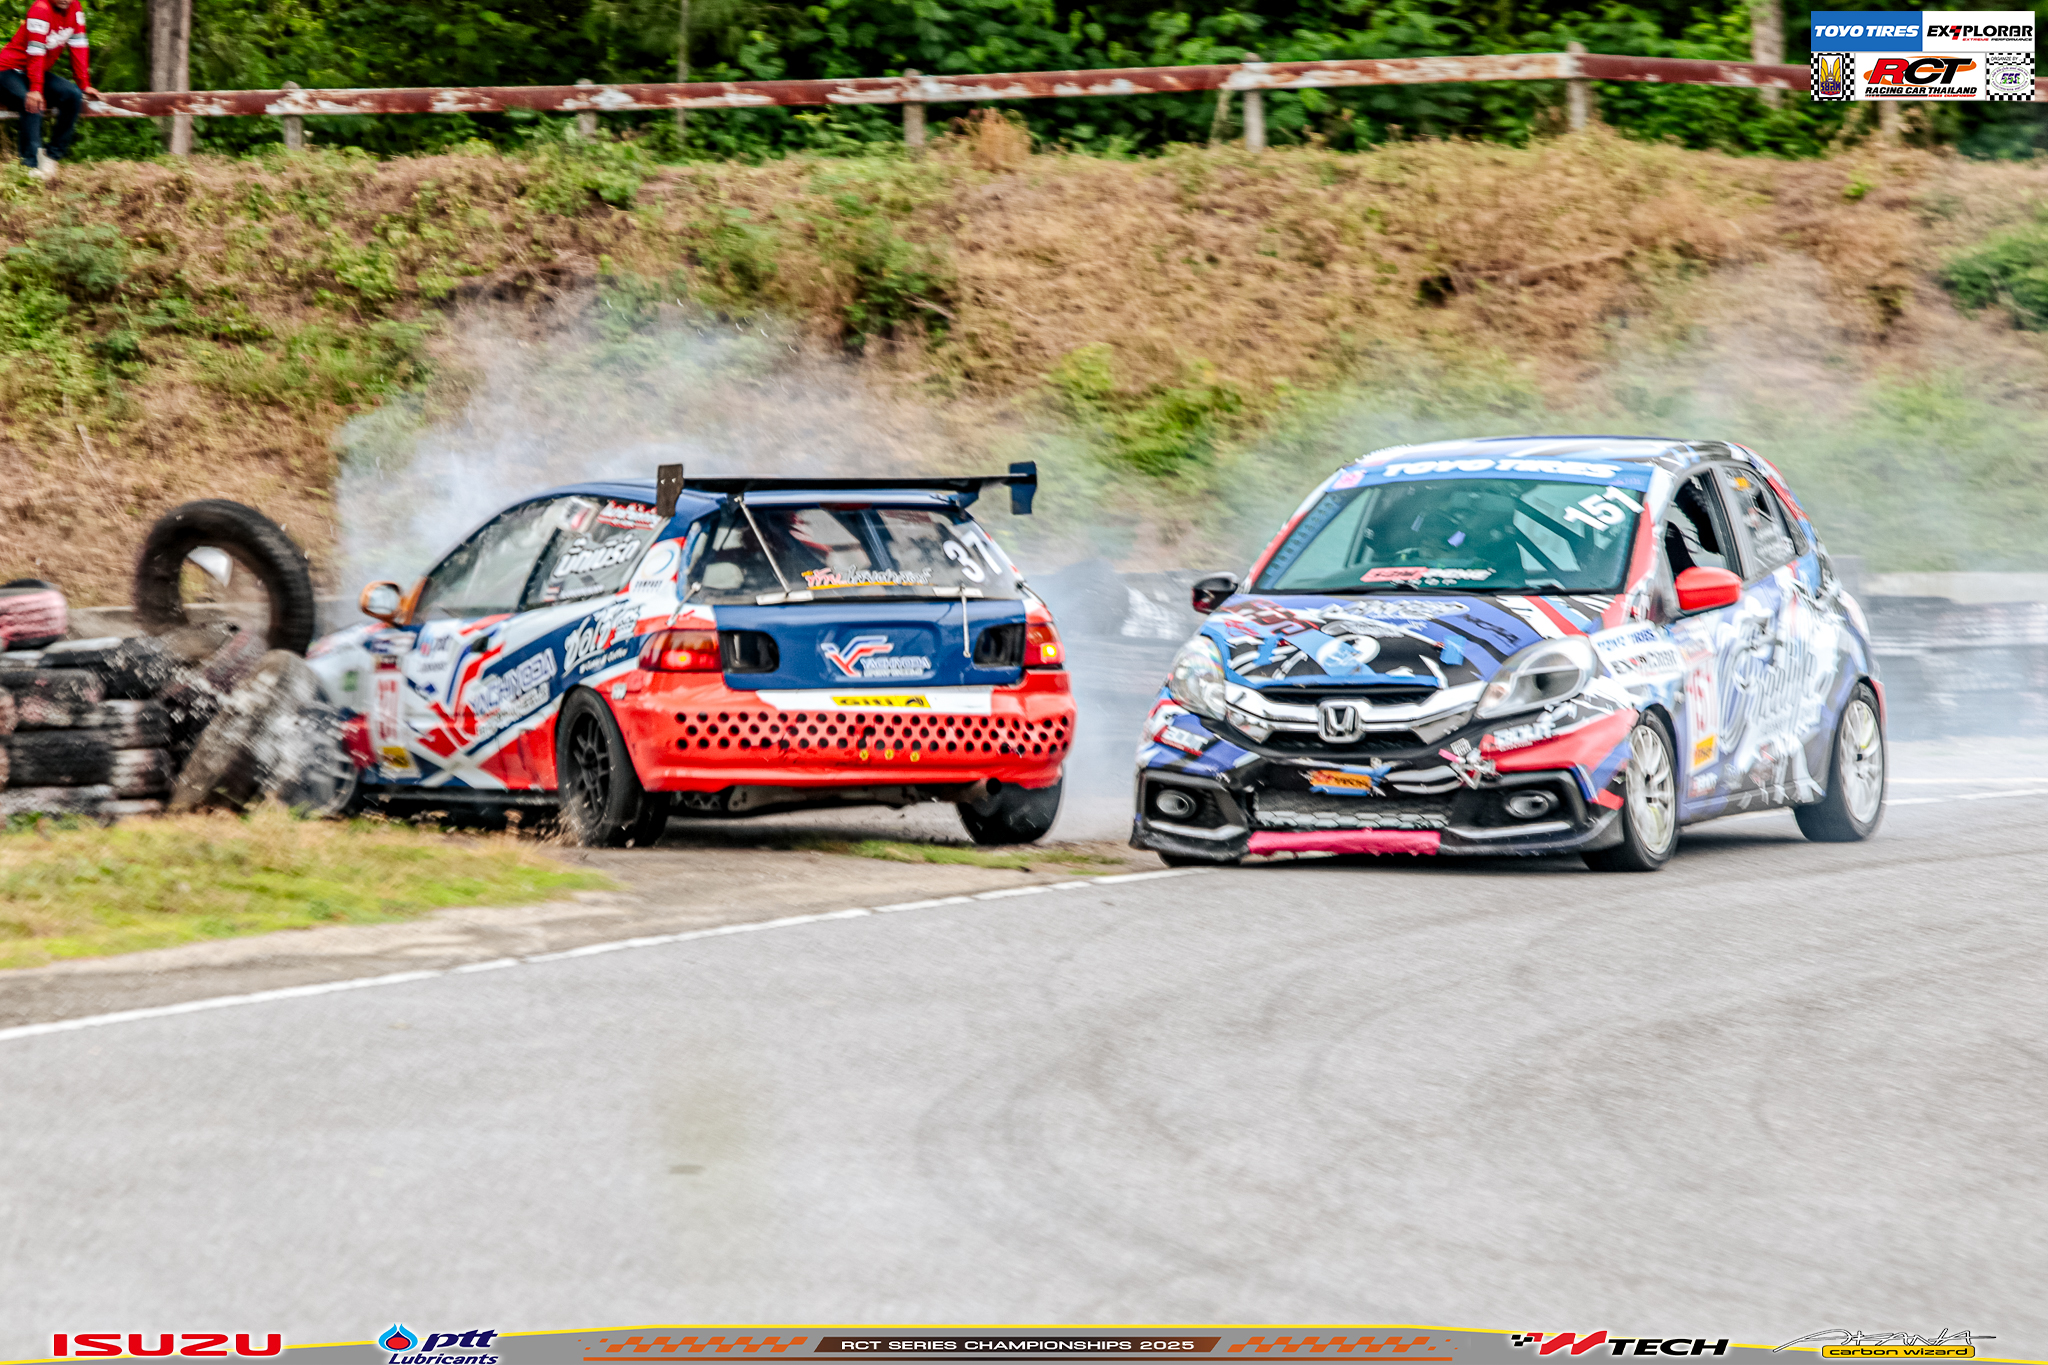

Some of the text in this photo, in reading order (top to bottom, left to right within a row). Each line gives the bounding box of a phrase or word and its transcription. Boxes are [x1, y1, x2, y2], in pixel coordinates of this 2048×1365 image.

[1383, 458, 1623, 479] TOYO TIRES
[1563, 485, 1645, 532] 151
[943, 530, 1003, 583] 37
